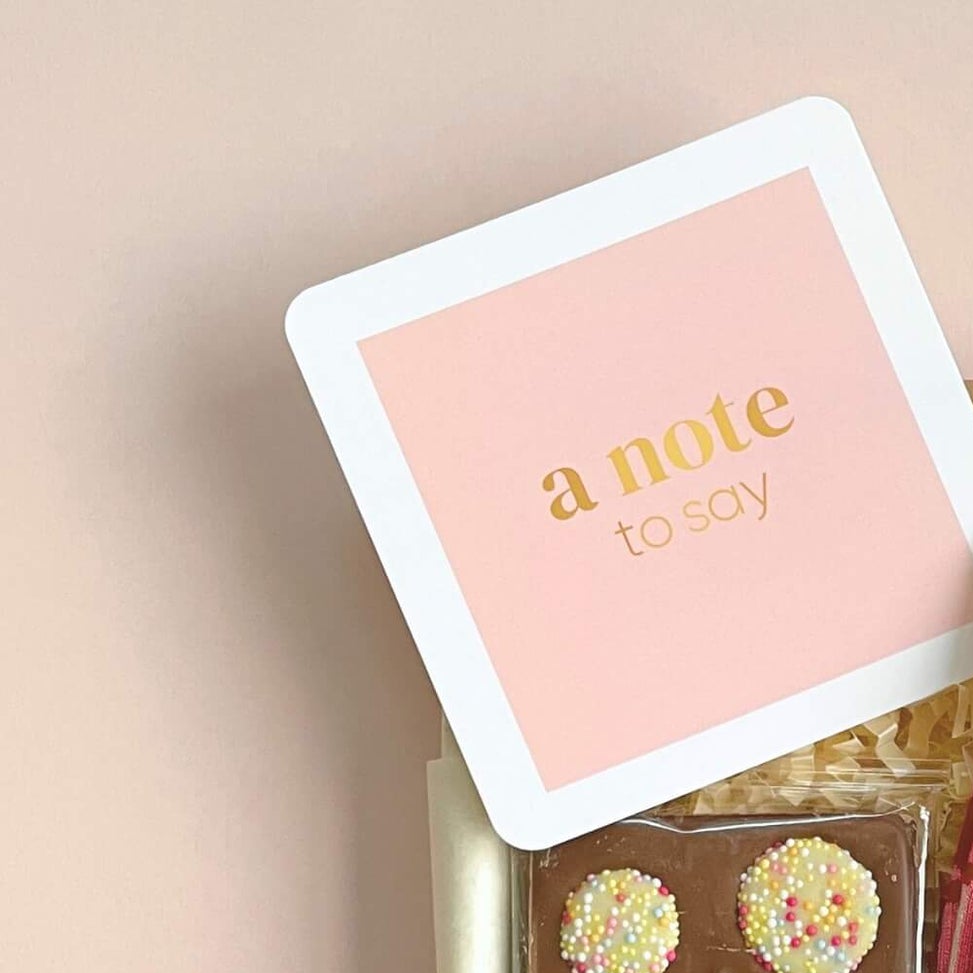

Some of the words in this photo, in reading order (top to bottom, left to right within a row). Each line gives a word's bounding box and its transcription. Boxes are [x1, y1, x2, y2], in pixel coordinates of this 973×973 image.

[542, 467, 599, 521] a
[606, 387, 795, 497] note
[614, 515, 673, 556] to
[682, 472, 767, 532] say
